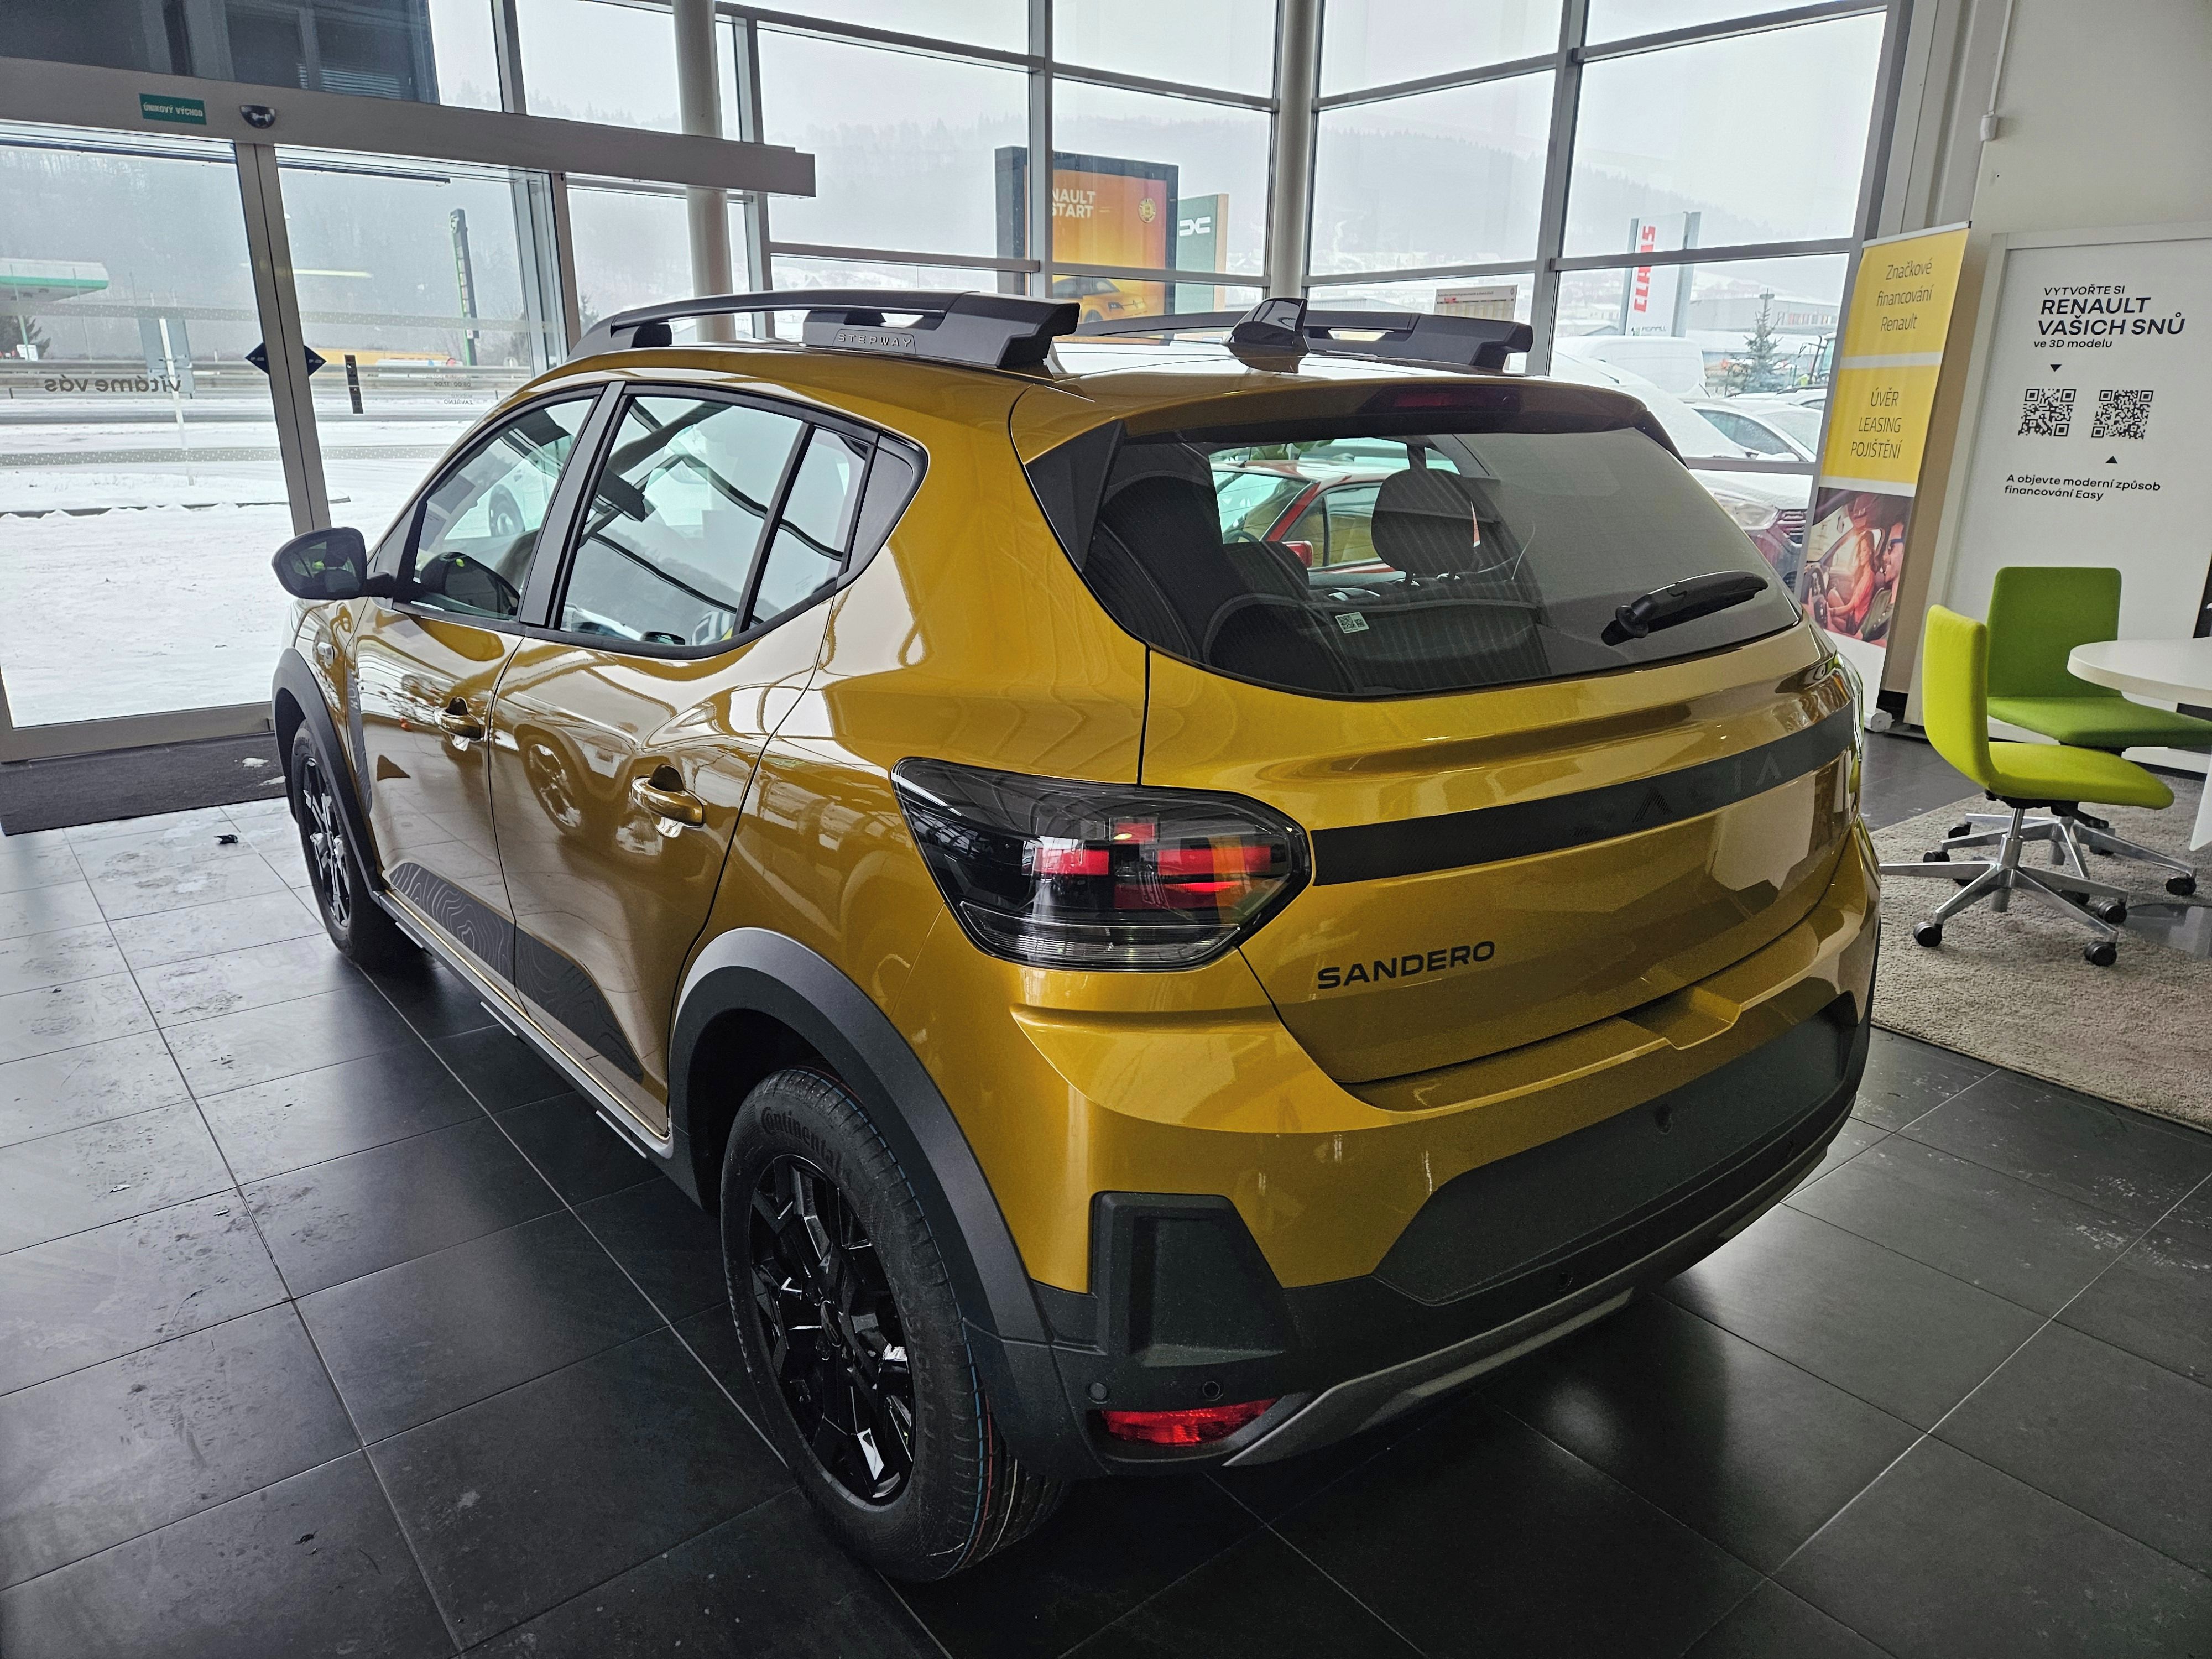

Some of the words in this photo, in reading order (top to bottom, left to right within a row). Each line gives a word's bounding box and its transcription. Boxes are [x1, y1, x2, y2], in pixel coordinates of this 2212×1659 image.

[175, 106, 203, 117] VÝCHOD
[1052, 188, 1096, 204] NAULT
[1886, 257, 1932, 280] Značkové
[1876, 284, 1934, 306] financování
[2044, 284, 2111, 296] VYTVOŘTE
[2114, 285, 2125, 294] SI
[2041, 297, 2151, 315] RENAULT
[1881, 313, 1918, 331] Renault
[2038, 315, 2126, 335] VAŠICH
[2131, 312, 2185, 335] SNŮ
[837, 333, 911, 348] STEPWAY
[2049, 340, 2064, 348] 3D
[2067, 338, 2112, 348] modelu
[1871, 387, 1899, 406] ÚVĚR
[1859, 417, 1902, 433] LEASING
[1850, 438, 1903, 458] POJIŠTĚNÍ
[2006, 474, 2015, 483] A
[2018, 474, 2060, 486] objevte
[2063, 478, 2115, 488] moderní
[2116, 479, 2161, 491] způsob
[2005, 485, 2073, 498] financování
[2075, 490, 2104, 502] Easy
[1317, 941, 1495, 989] SANDERO
[761, 1106, 842, 1178] Continental
